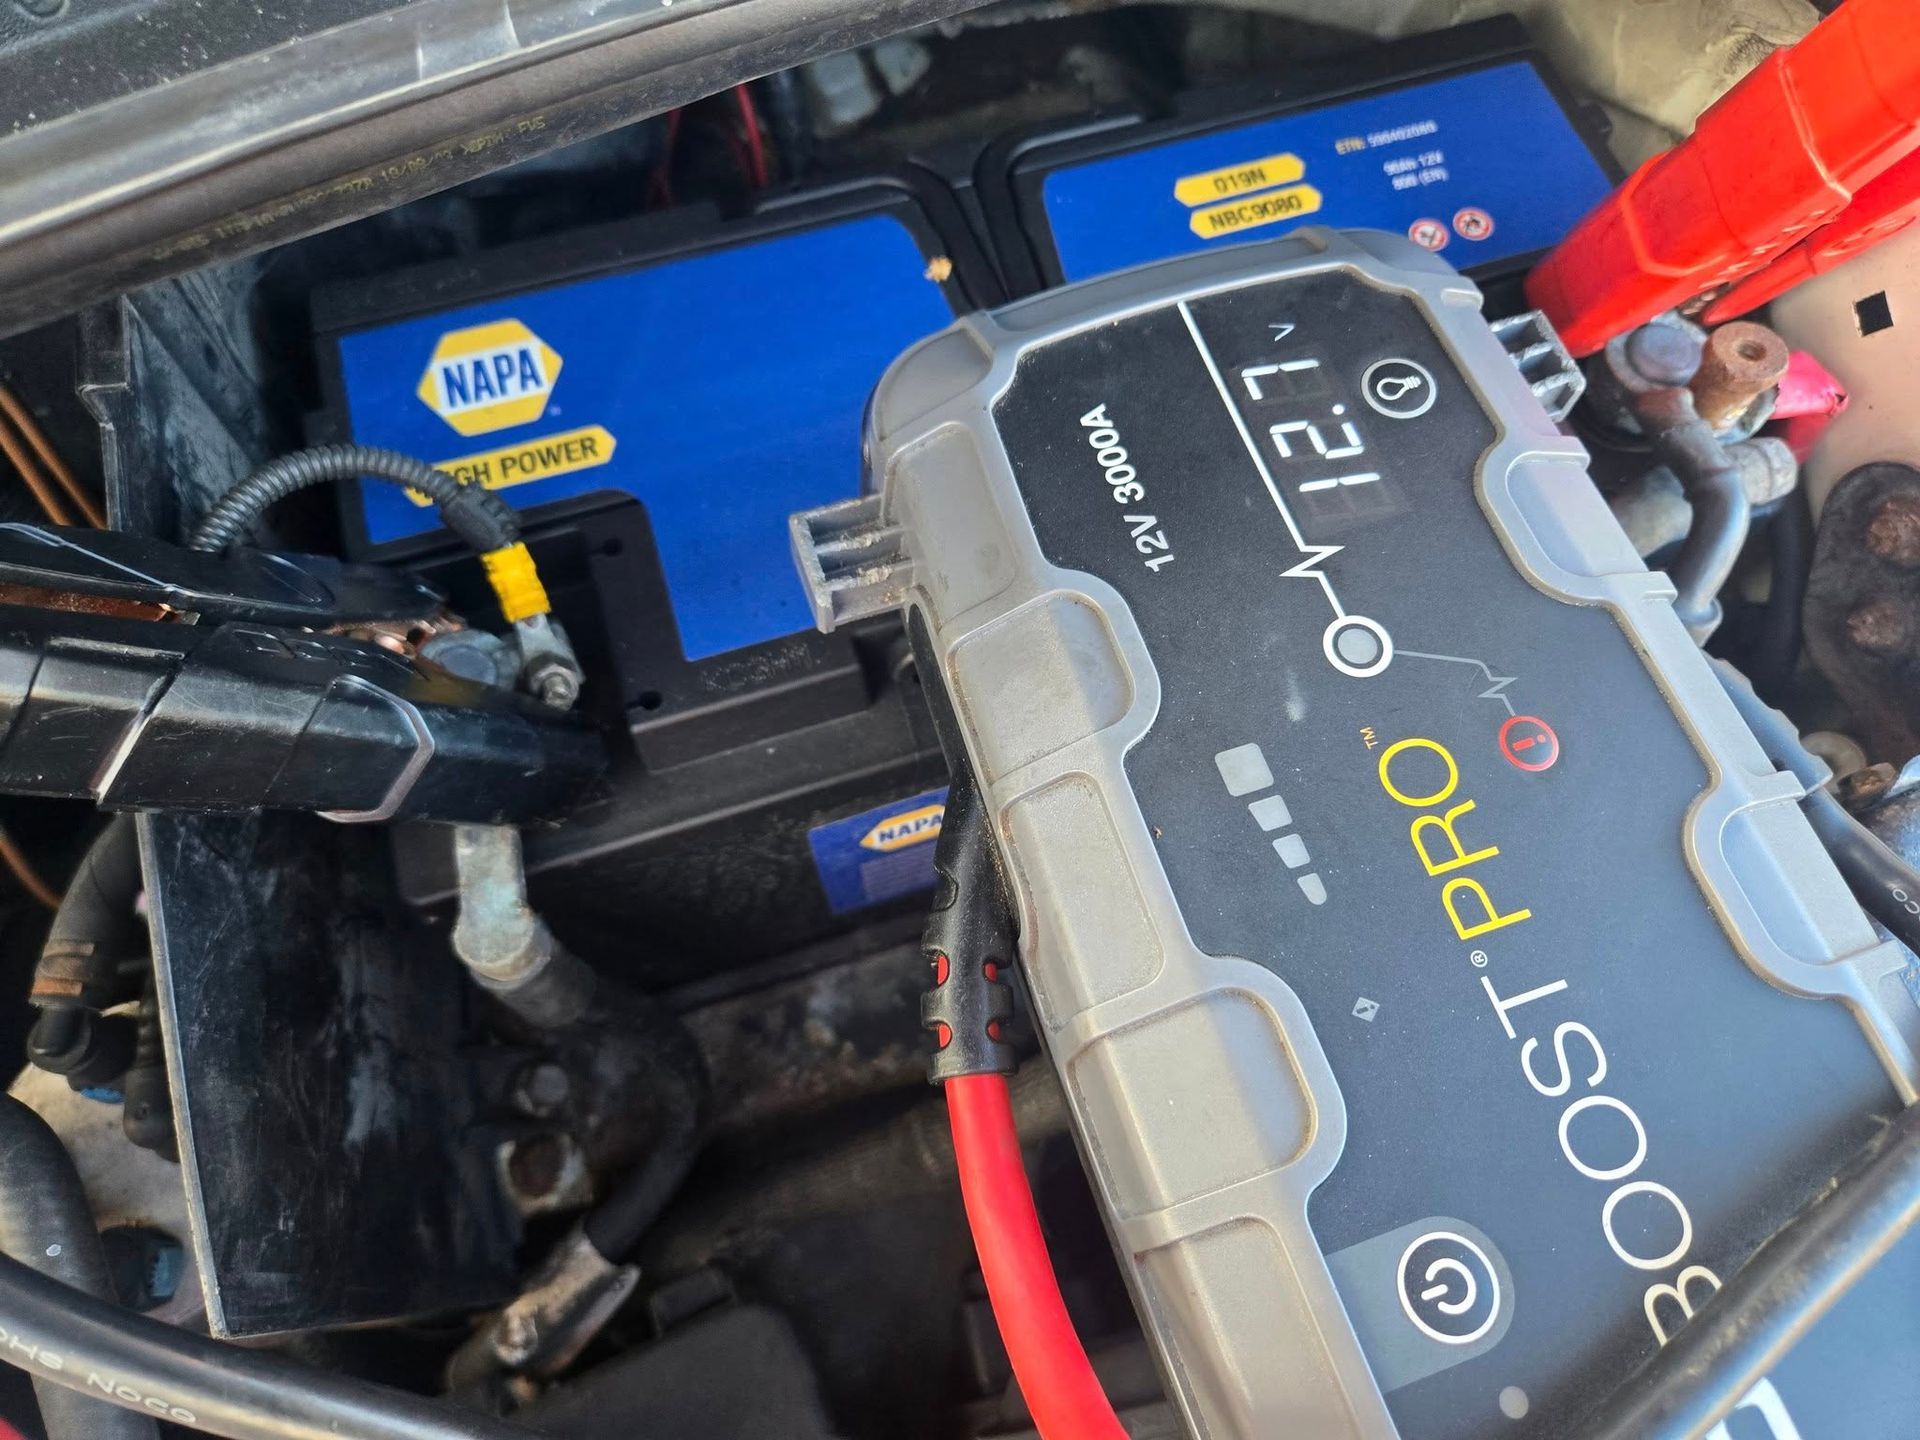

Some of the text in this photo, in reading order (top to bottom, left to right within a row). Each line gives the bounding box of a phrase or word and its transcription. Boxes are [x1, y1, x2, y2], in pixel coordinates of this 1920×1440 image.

[1213, 168, 1266, 194] 019N
[1208, 194, 1302, 231] NBC9080
[443, 348, 543, 408] NAPA
[1241, 359, 1381, 492] 12.7
[500, 436, 599, 480] POWER
[1080, 403, 1175, 572] 12V 3000A
[879, 813, 942, 843] NAPA
[1378, 738, 1532, 940] PRO
[1480, 974, 1721, 1346] BOOST
[87, 1372, 197, 1424] NOCO
